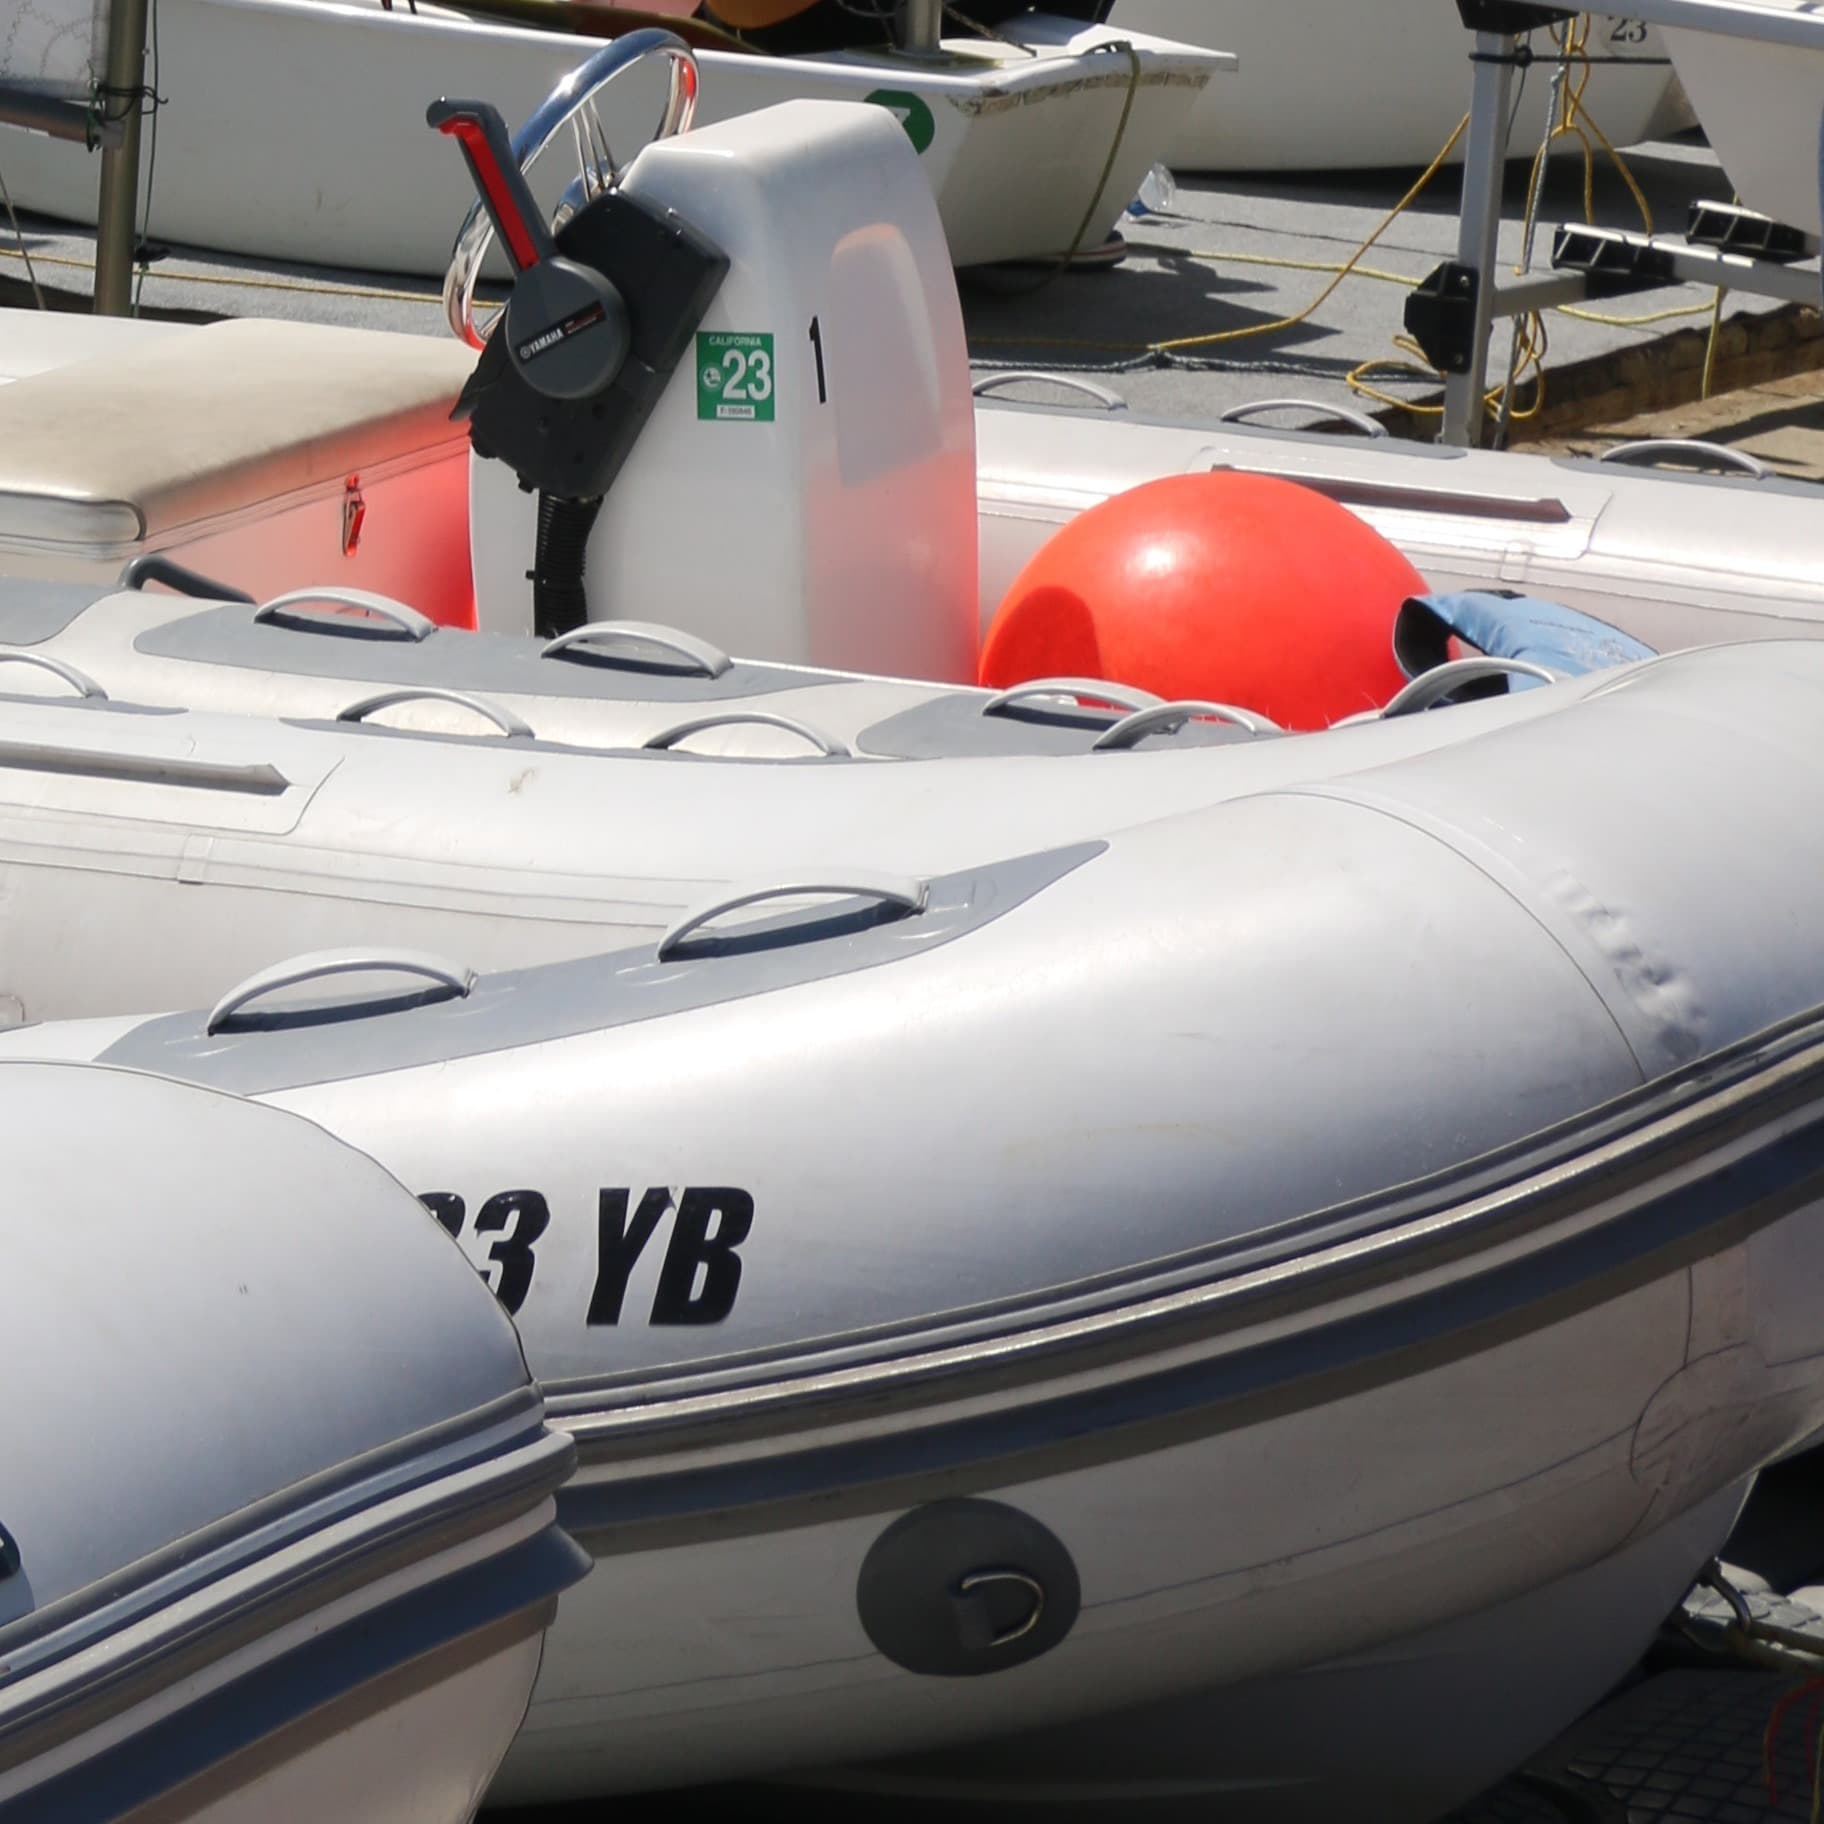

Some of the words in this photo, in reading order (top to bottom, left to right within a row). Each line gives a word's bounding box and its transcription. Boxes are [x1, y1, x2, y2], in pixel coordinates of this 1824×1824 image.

[529, 327, 565, 355] YAMAHA
[708, 336, 763, 347] CALIFORNIA
[808, 316, 826, 404] 1
[722, 348, 773, 401] 23
[584, 1186, 755, 1328] YB
